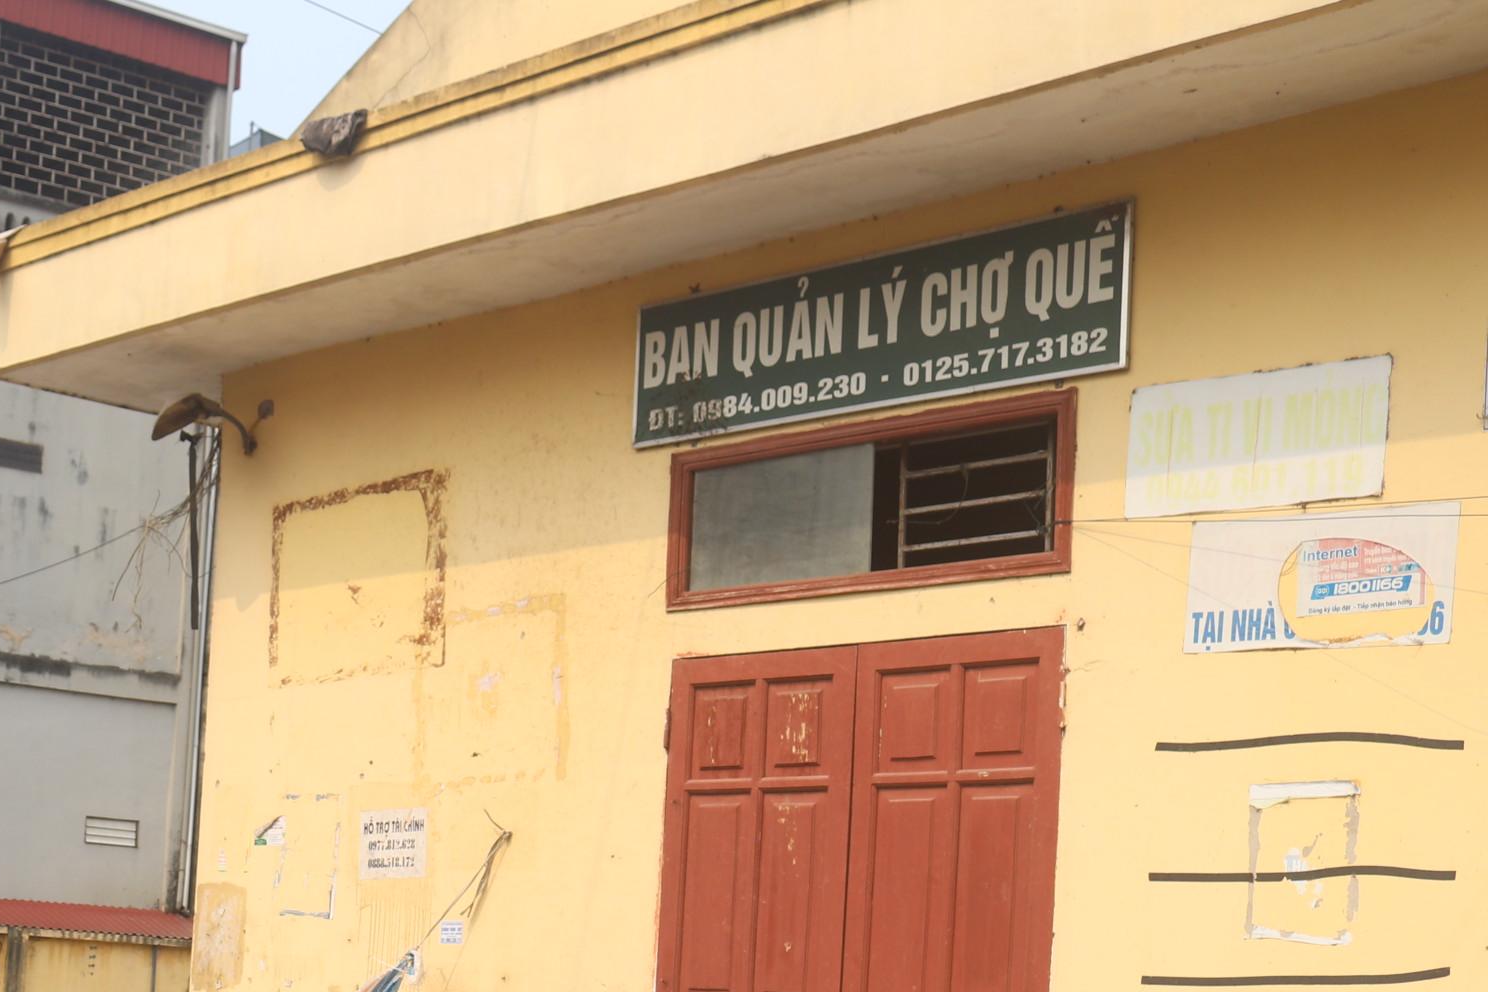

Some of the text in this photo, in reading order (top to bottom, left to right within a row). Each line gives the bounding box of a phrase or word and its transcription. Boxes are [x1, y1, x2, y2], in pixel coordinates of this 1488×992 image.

[643, 317, 720, 390] BAN
[732, 276, 844, 377] QUẢN
[858, 266, 908, 350] LÝ
[920, 250, 1013, 339] CHỢ
[692, 372, 866, 424] 0984.009.230
[903, 327, 1108, 387] 0125.717.3182
[1207, 400, 1232, 460] TI
[1243, 396, 1273, 457] VI
[1303, 546, 1359, 562] Internet
[1333, 577, 1403, 595] 18001166
[1191, 611, 1224, 651] TẠI
[1230, 600, 1276, 642] NHÀ
[376, 821, 390, 838] TRỢ
[392, 817, 402, 833] TÀI
[404, 816, 424, 833] CHÍNH
